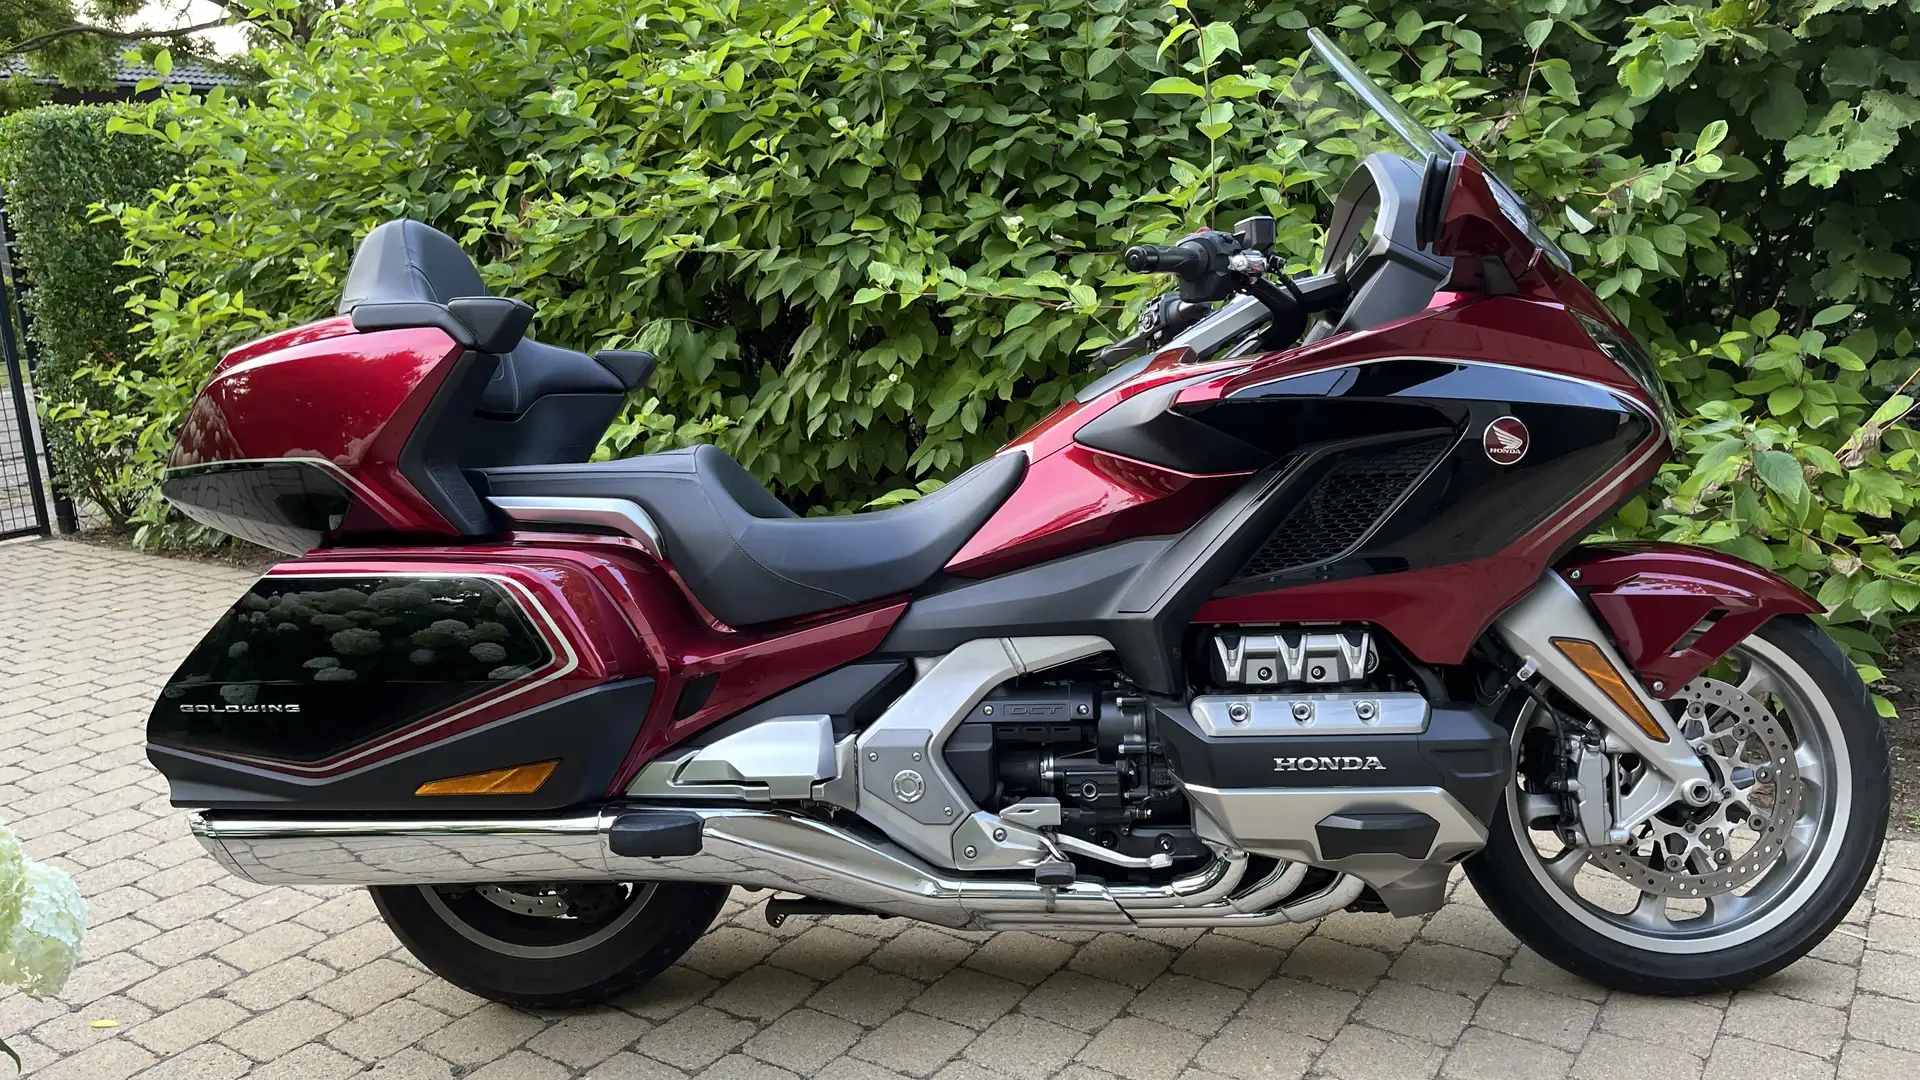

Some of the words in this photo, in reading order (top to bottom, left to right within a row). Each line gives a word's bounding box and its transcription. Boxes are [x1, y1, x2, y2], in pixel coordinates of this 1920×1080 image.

[179, 704, 301, 713] GOLDWING
[1009, 706, 1064, 715] DCT
[1273, 756, 1387, 771] HONDA
